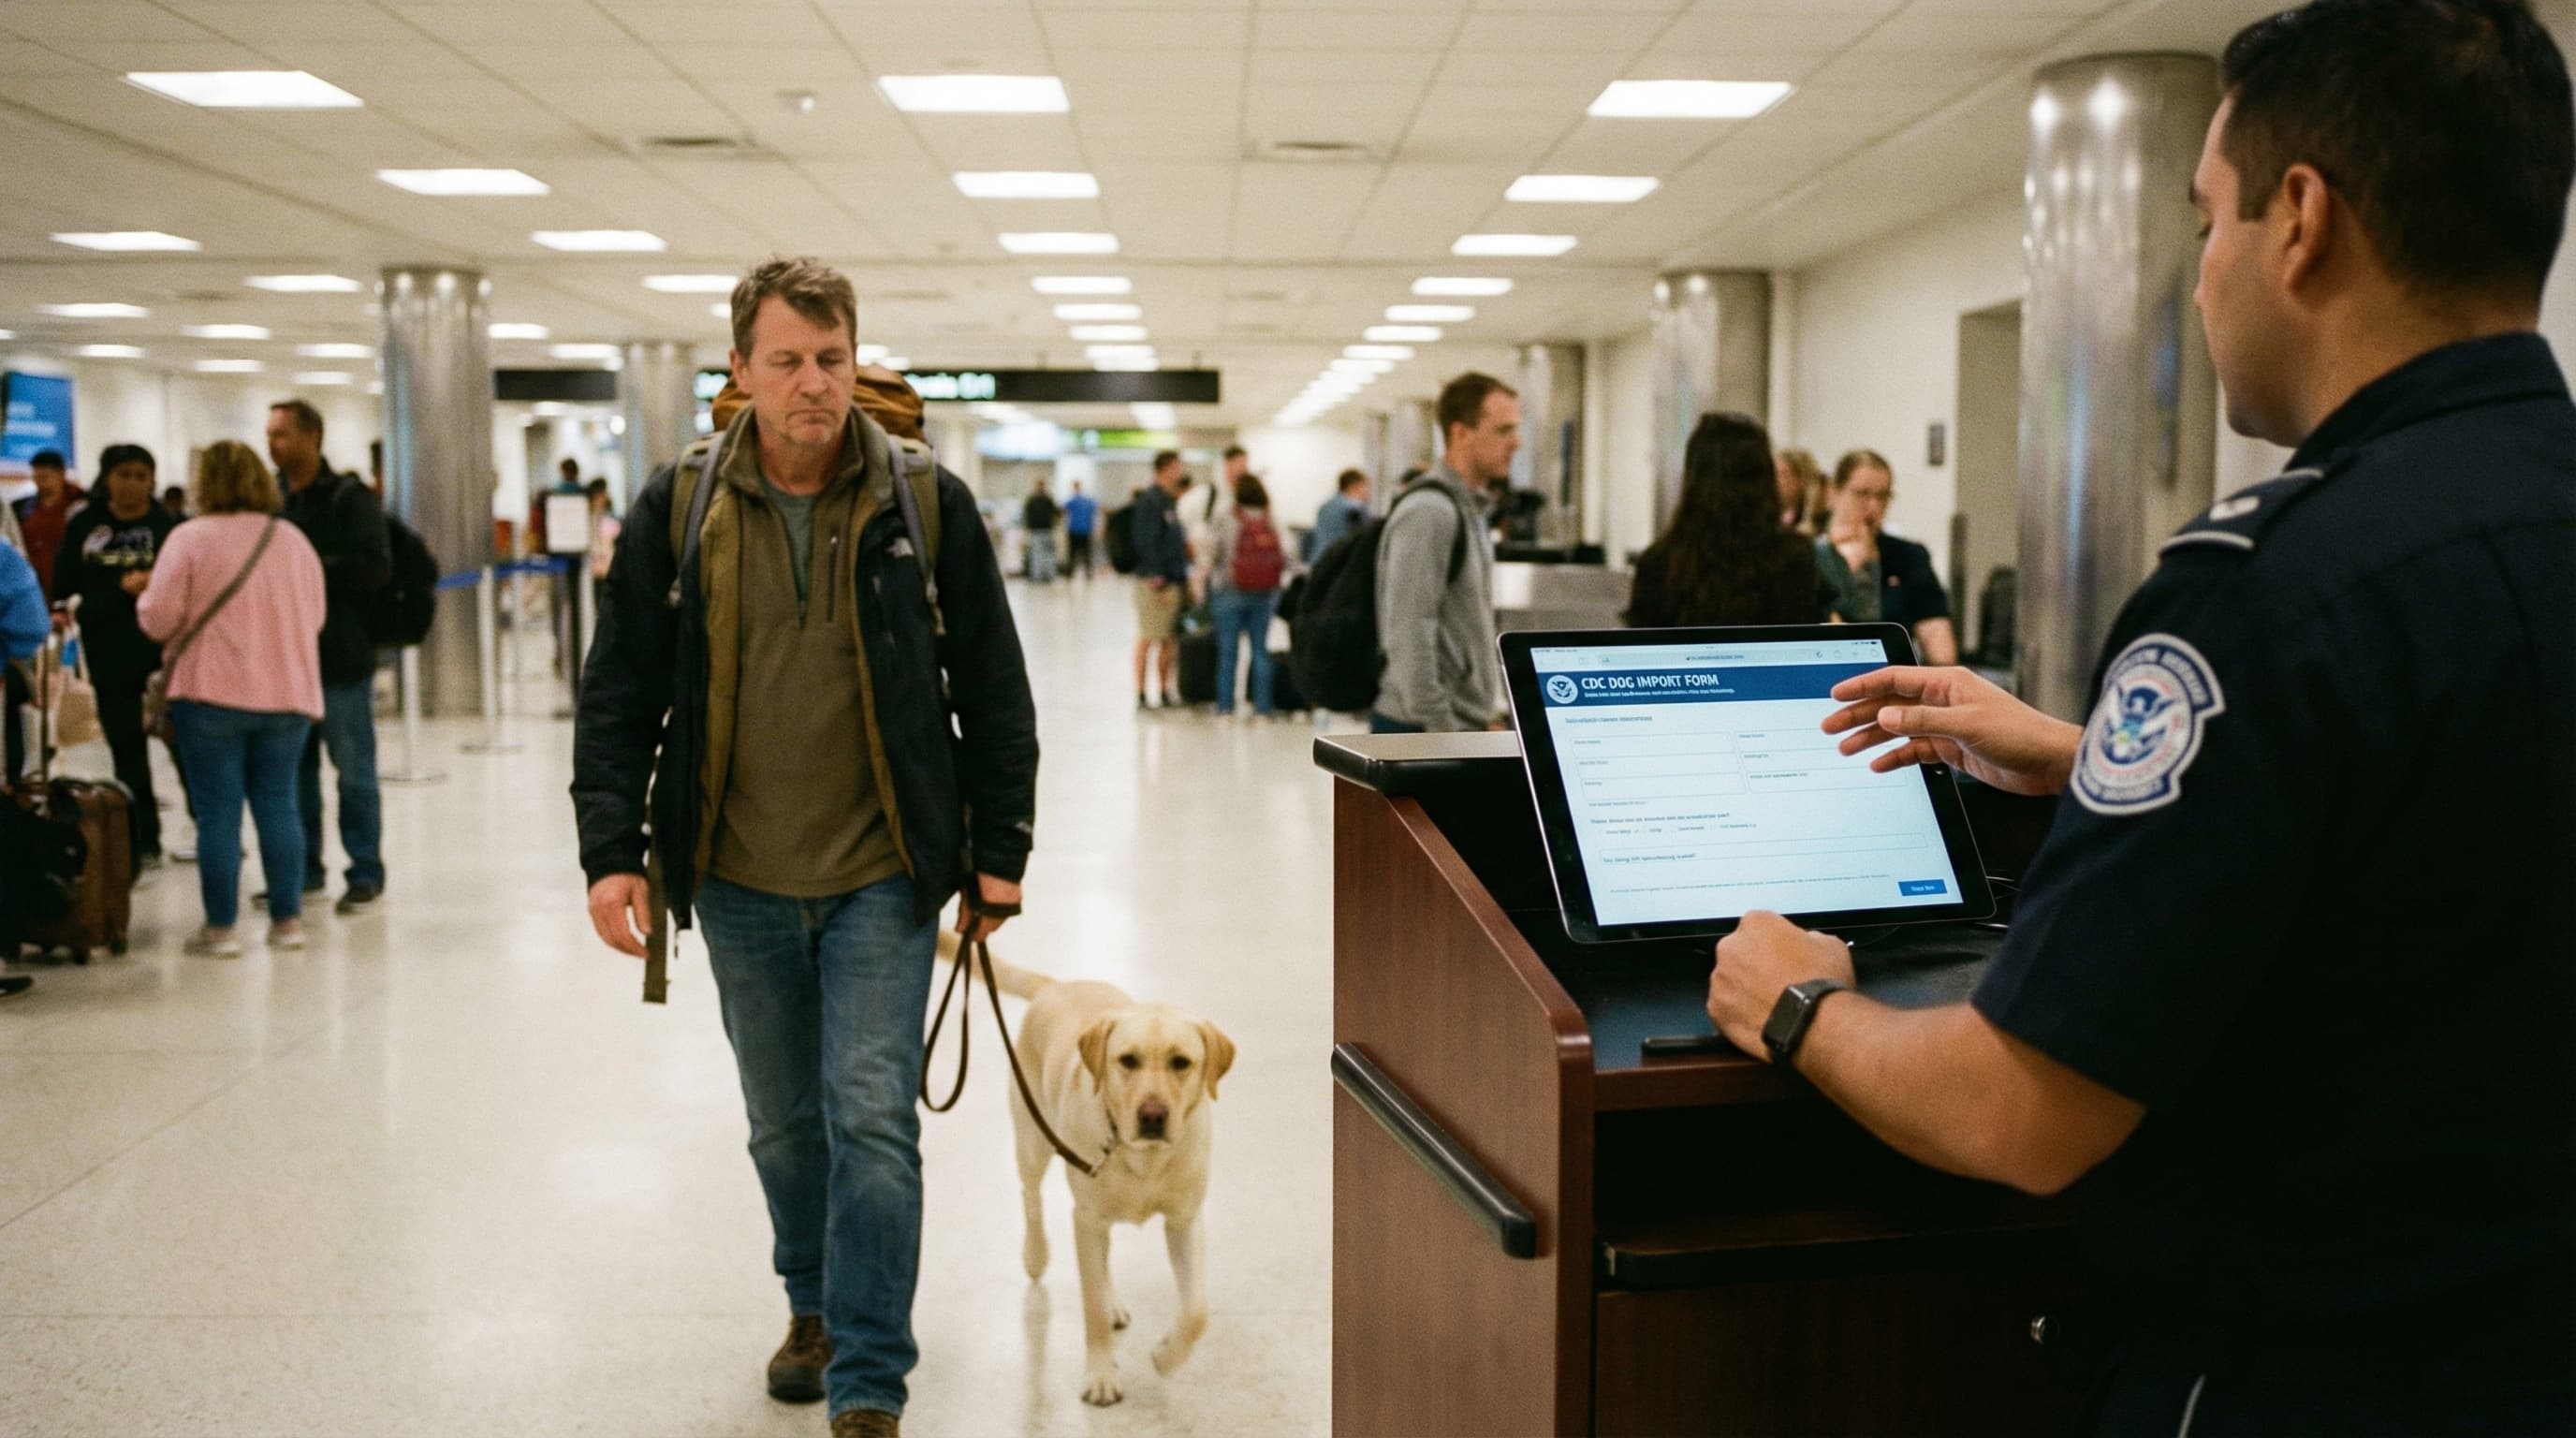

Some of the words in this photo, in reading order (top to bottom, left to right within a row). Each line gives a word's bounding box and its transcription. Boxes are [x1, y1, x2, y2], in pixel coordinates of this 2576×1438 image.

[1581, 677, 1606, 689] CDC
[1608, 676, 1634, 689] DOG
[1636, 675, 1681, 688] IMPORT
[1684, 673, 1720, 686] FORM
